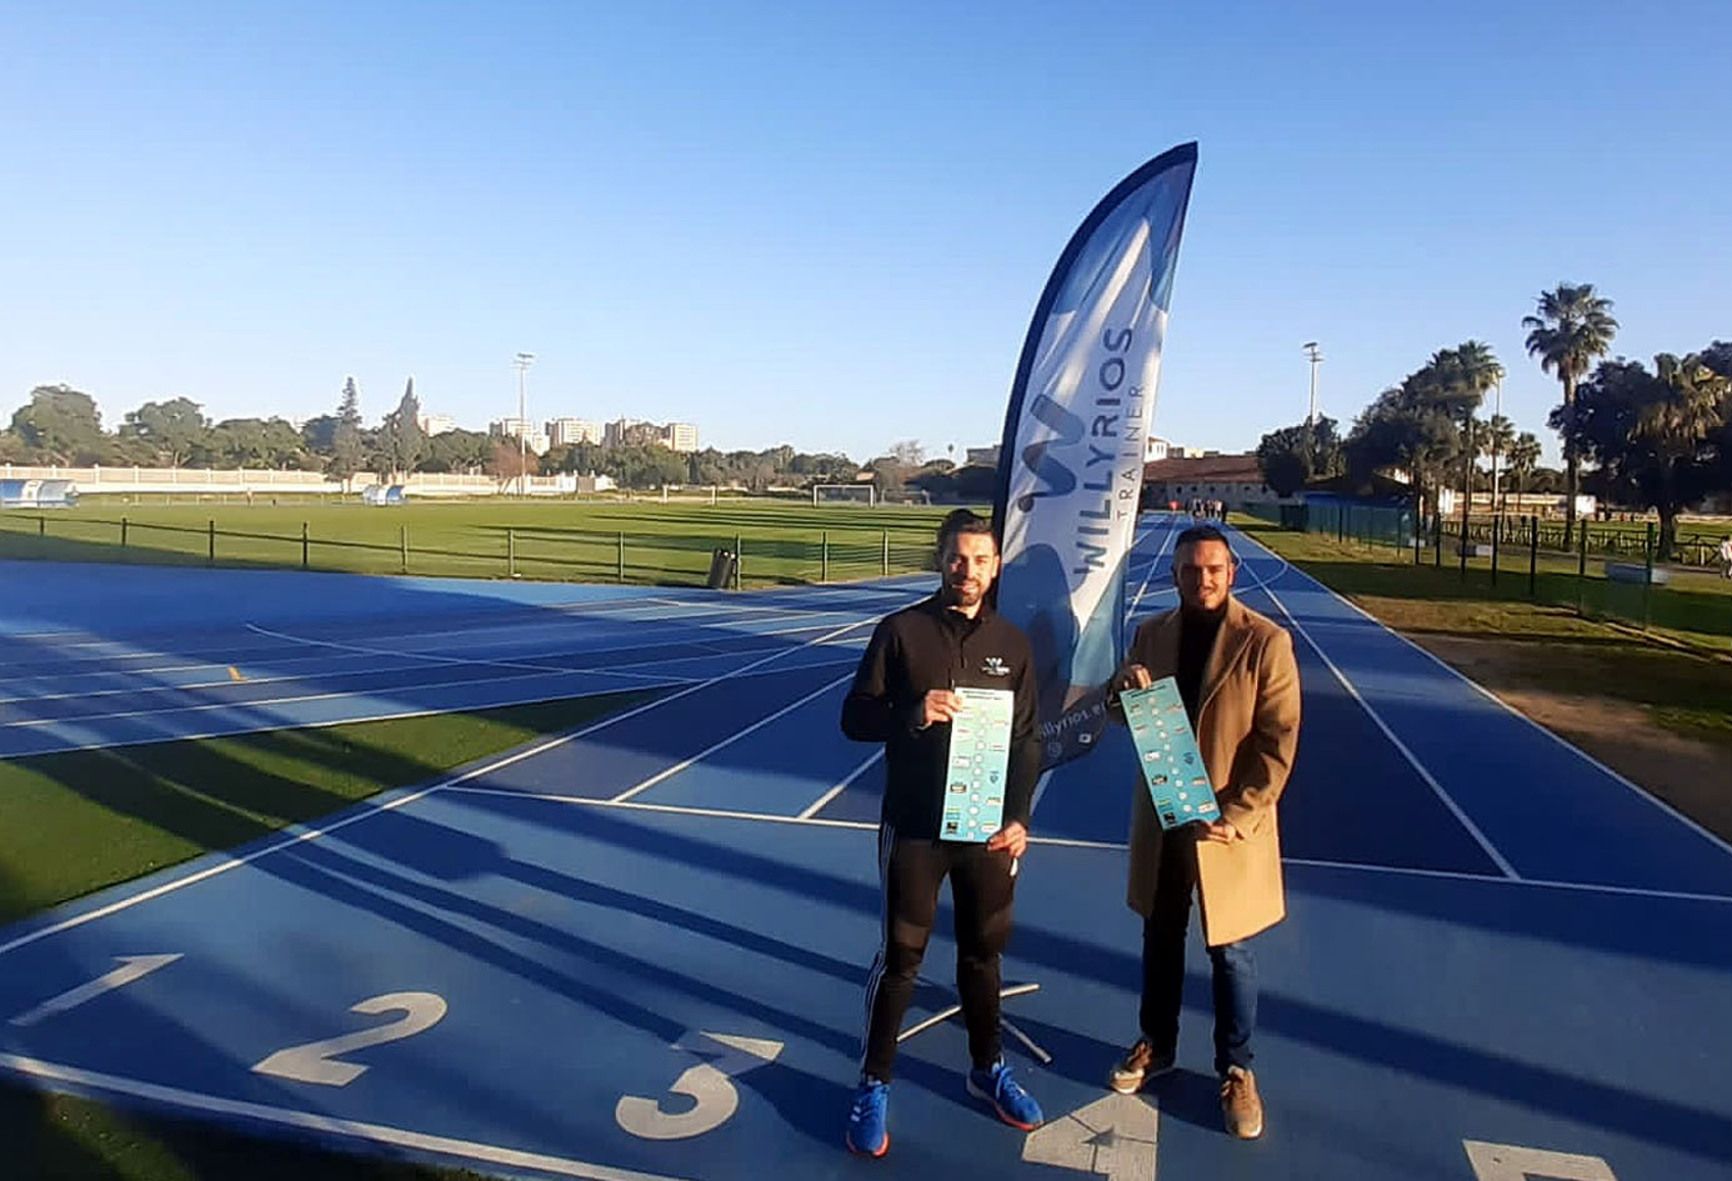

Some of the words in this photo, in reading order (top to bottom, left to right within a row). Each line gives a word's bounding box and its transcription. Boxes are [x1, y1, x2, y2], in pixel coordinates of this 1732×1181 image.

[1073, 327, 1133, 575] WILLYRIOS
[1116, 385, 1145, 521] TRAINER
[250, 991, 448, 1087] 2
[615, 1030, 785, 1140] 3
